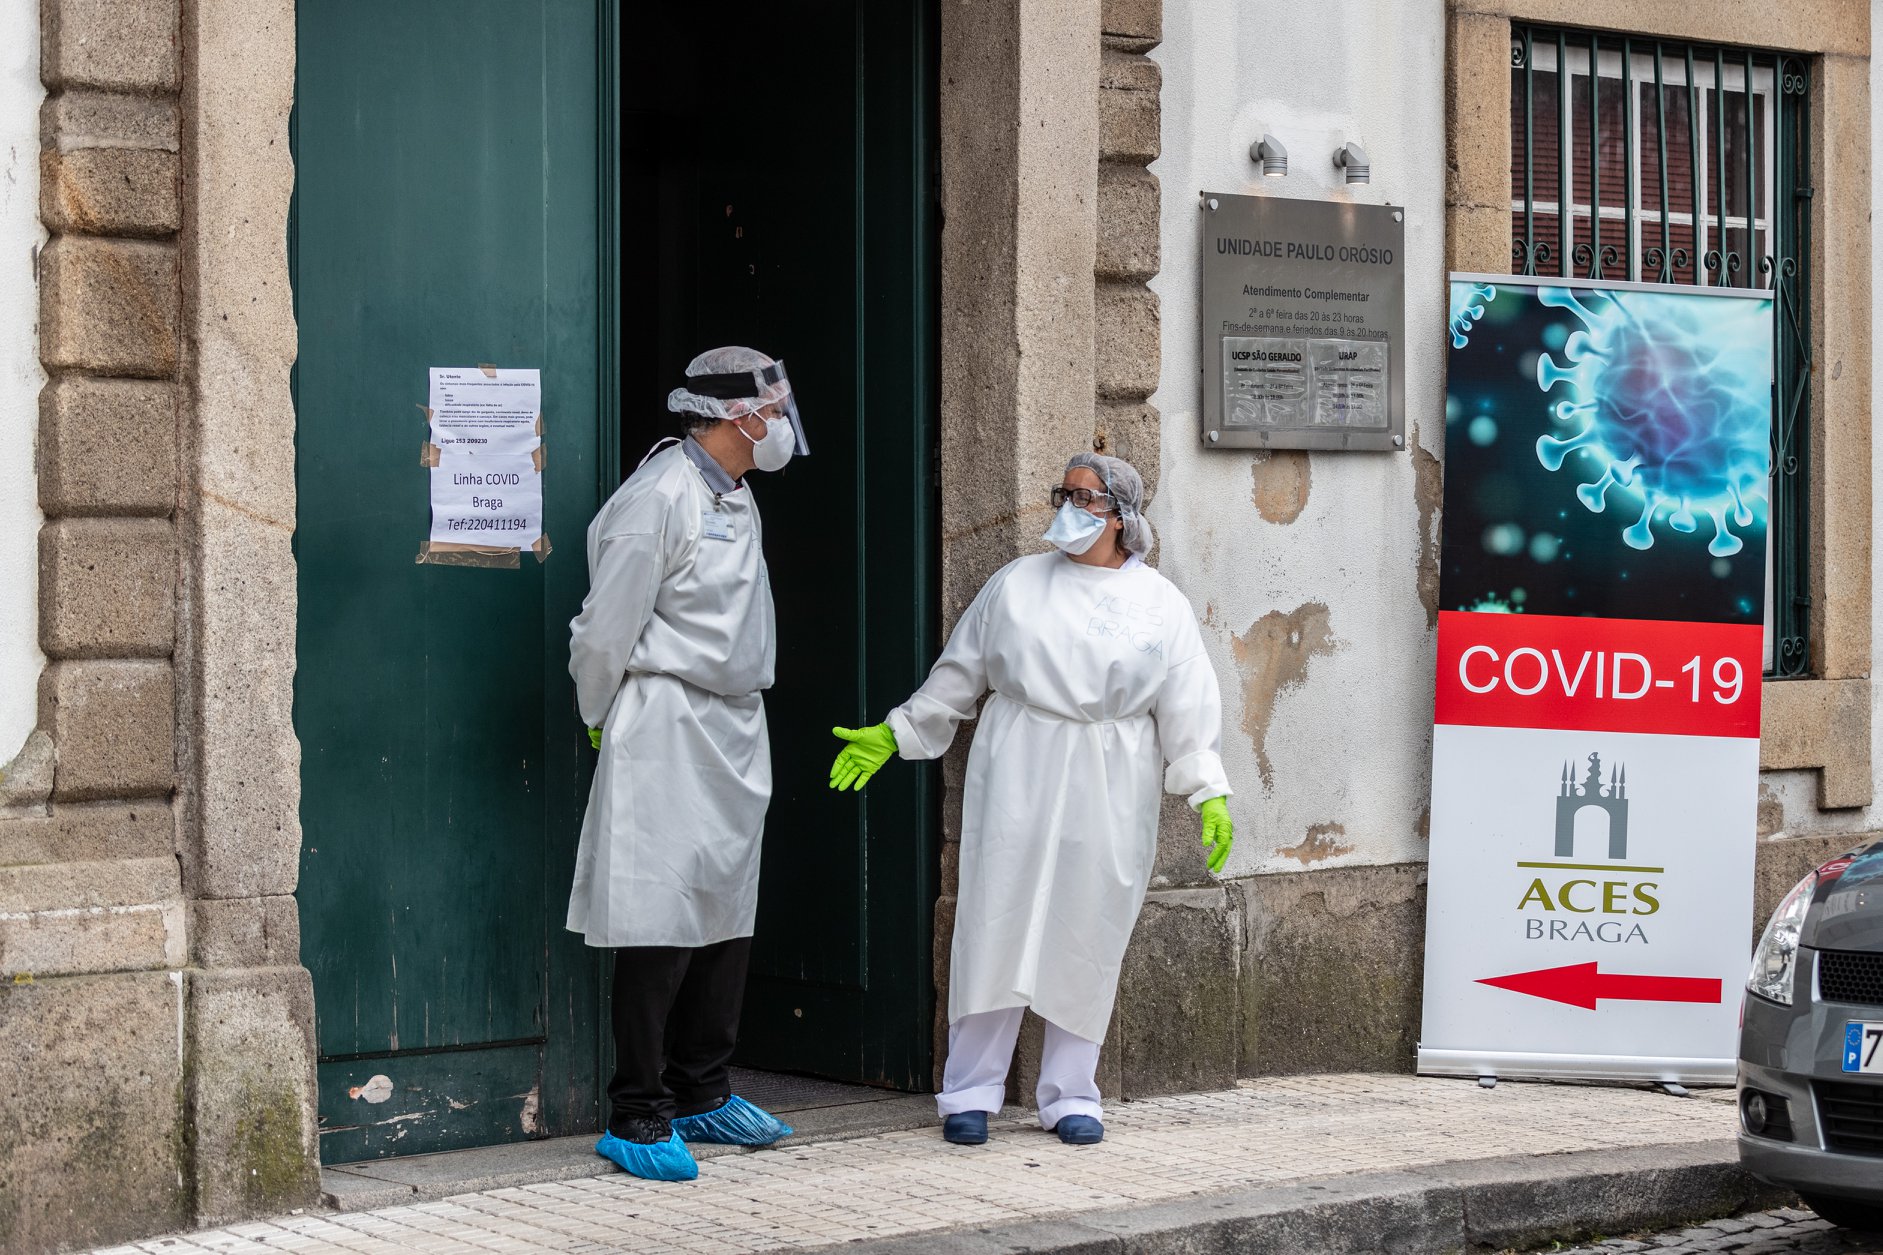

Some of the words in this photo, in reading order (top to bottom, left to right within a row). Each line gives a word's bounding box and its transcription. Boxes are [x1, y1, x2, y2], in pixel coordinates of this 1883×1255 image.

[1217, 238, 1283, 258] UNIDADE
[1287, 242, 1335, 261] PAULO
[1339, 243, 1393, 265] ORÓSIO
[1243, 284, 1302, 299] Atendimento
[1304, 287, 1369, 303] Complementar
[1276, 309, 1293, 320] feira
[1295, 311, 1308, 321] das
[1310, 311, 1320, 321] 20
[1321, 312, 1331, 322] às
[1332, 313, 1342, 322] 23
[1344, 313, 1364, 324] horas
[1222, 321, 1284, 333] Fins-de-semana
[1293, 323, 1323, 336] feriados
[1325, 325, 1338, 336] das
[1339, 326, 1345, 336] 9
[1346, 327, 1355, 337] às
[1357, 327, 1367, 337] 20
[1368, 328, 1388, 339] horas
[1232, 351, 1251, 360] UCSP
[1252, 350, 1267, 361] SÃO
[1268, 352, 1302, 362] GERALDO
[1338, 352, 1358, 361] URAP
[453, 473, 483, 486] Linha
[485, 473, 520, 486] COVID
[473, 496, 503, 510] Braga
[448, 518, 527, 531] Tef:220411194
[1094, 594, 1164, 626] ACES
[1086, 616, 1163, 661] BRAGA
[1458, 645, 1744, 705] COVID-19
[1517, 877, 1660, 916] ACES
[1525, 918, 1649, 944] BRAGA
[1848, 1052, 1857, 1065] P
